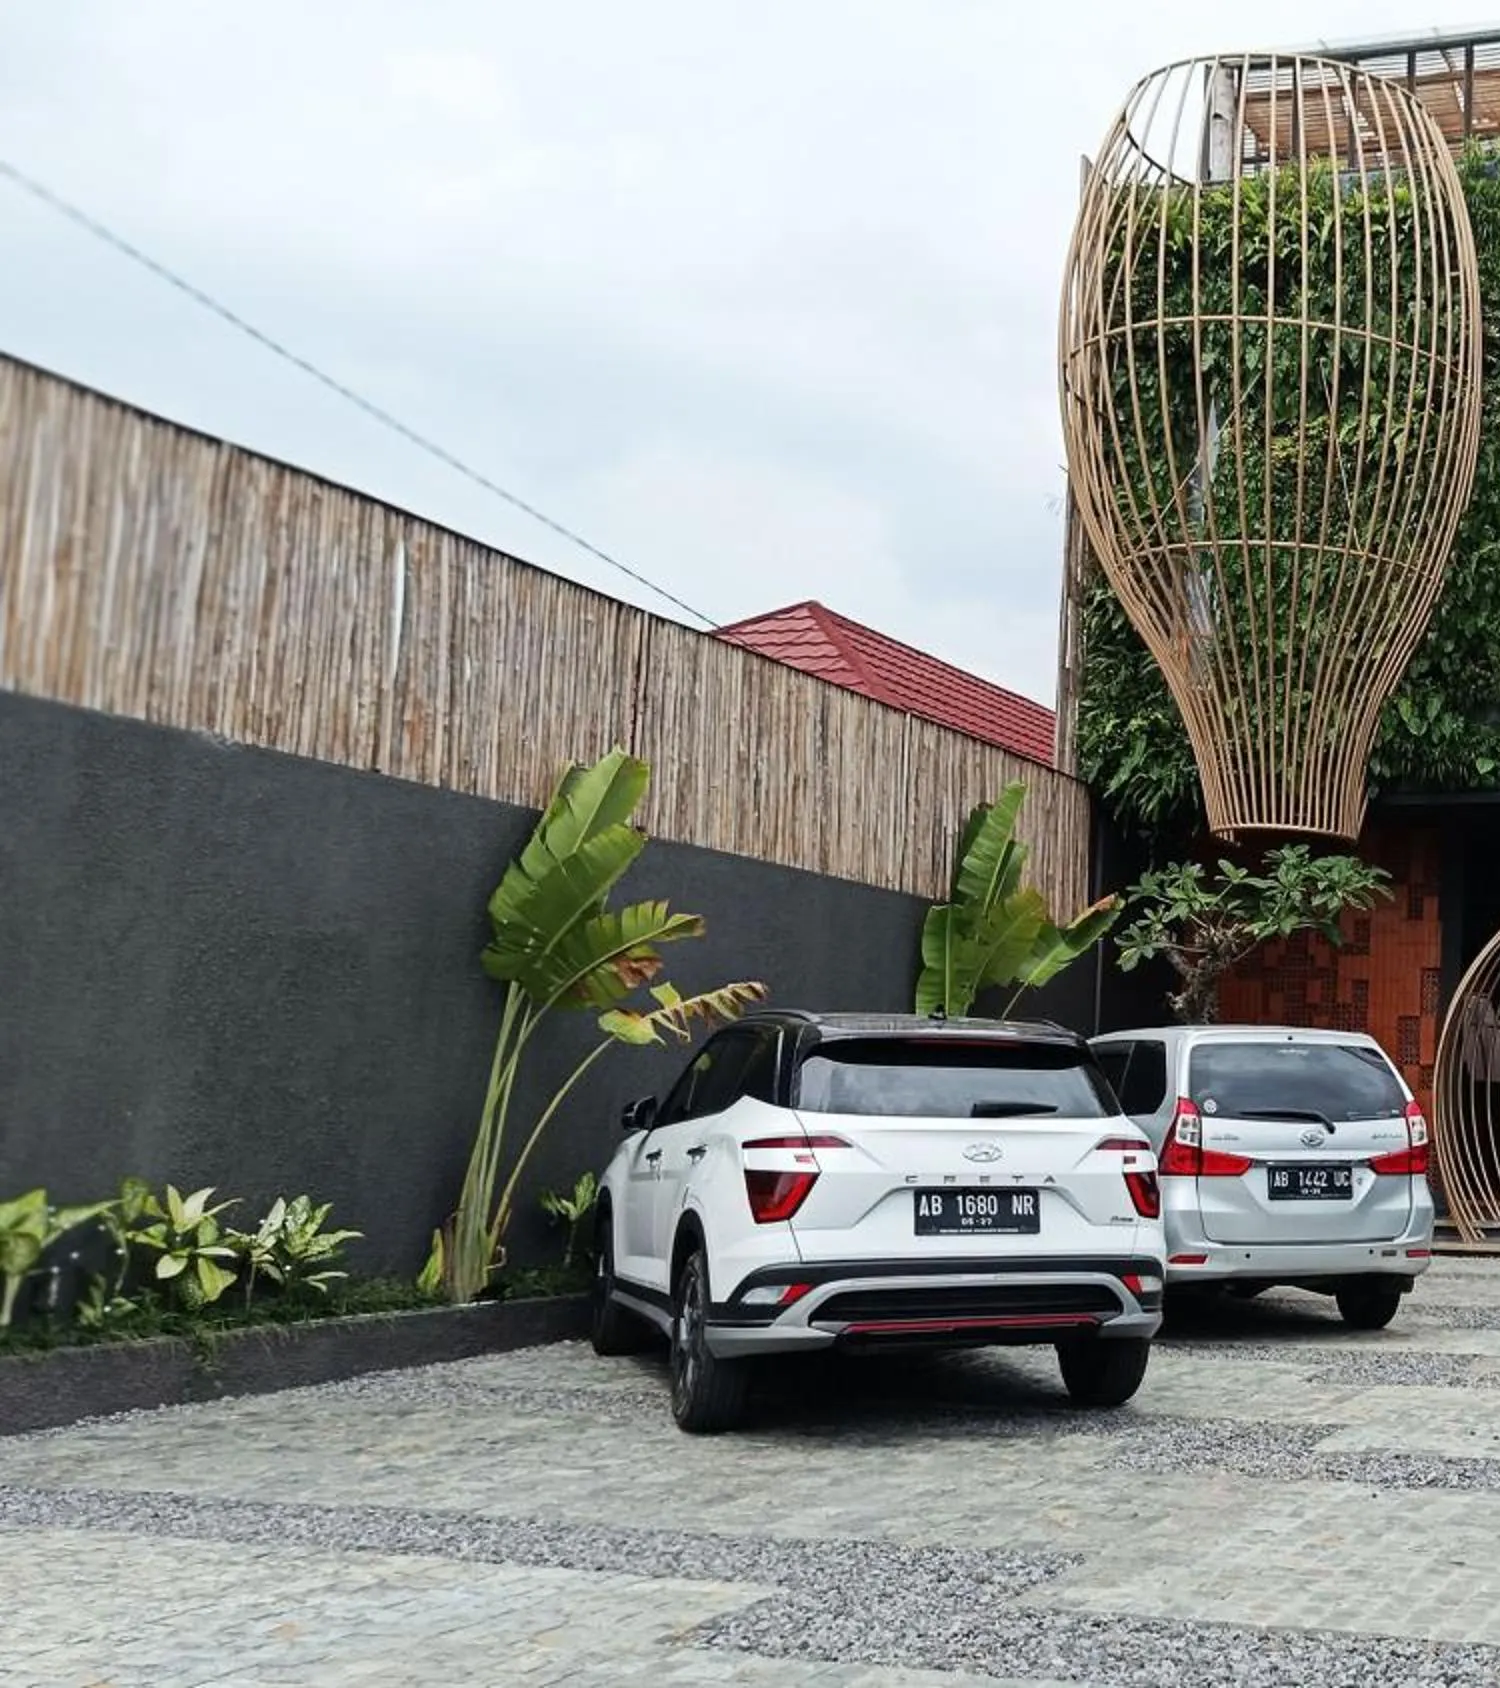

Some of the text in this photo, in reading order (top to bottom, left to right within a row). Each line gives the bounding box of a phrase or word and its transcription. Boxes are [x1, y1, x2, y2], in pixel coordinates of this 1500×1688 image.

[904, 1175, 1056, 1184] CRETA
[1274, 1171, 1289, 1187] AB
[1299, 1171, 1329, 1187] 1442
[919, 1194, 1035, 1216] AB 1680 NR
